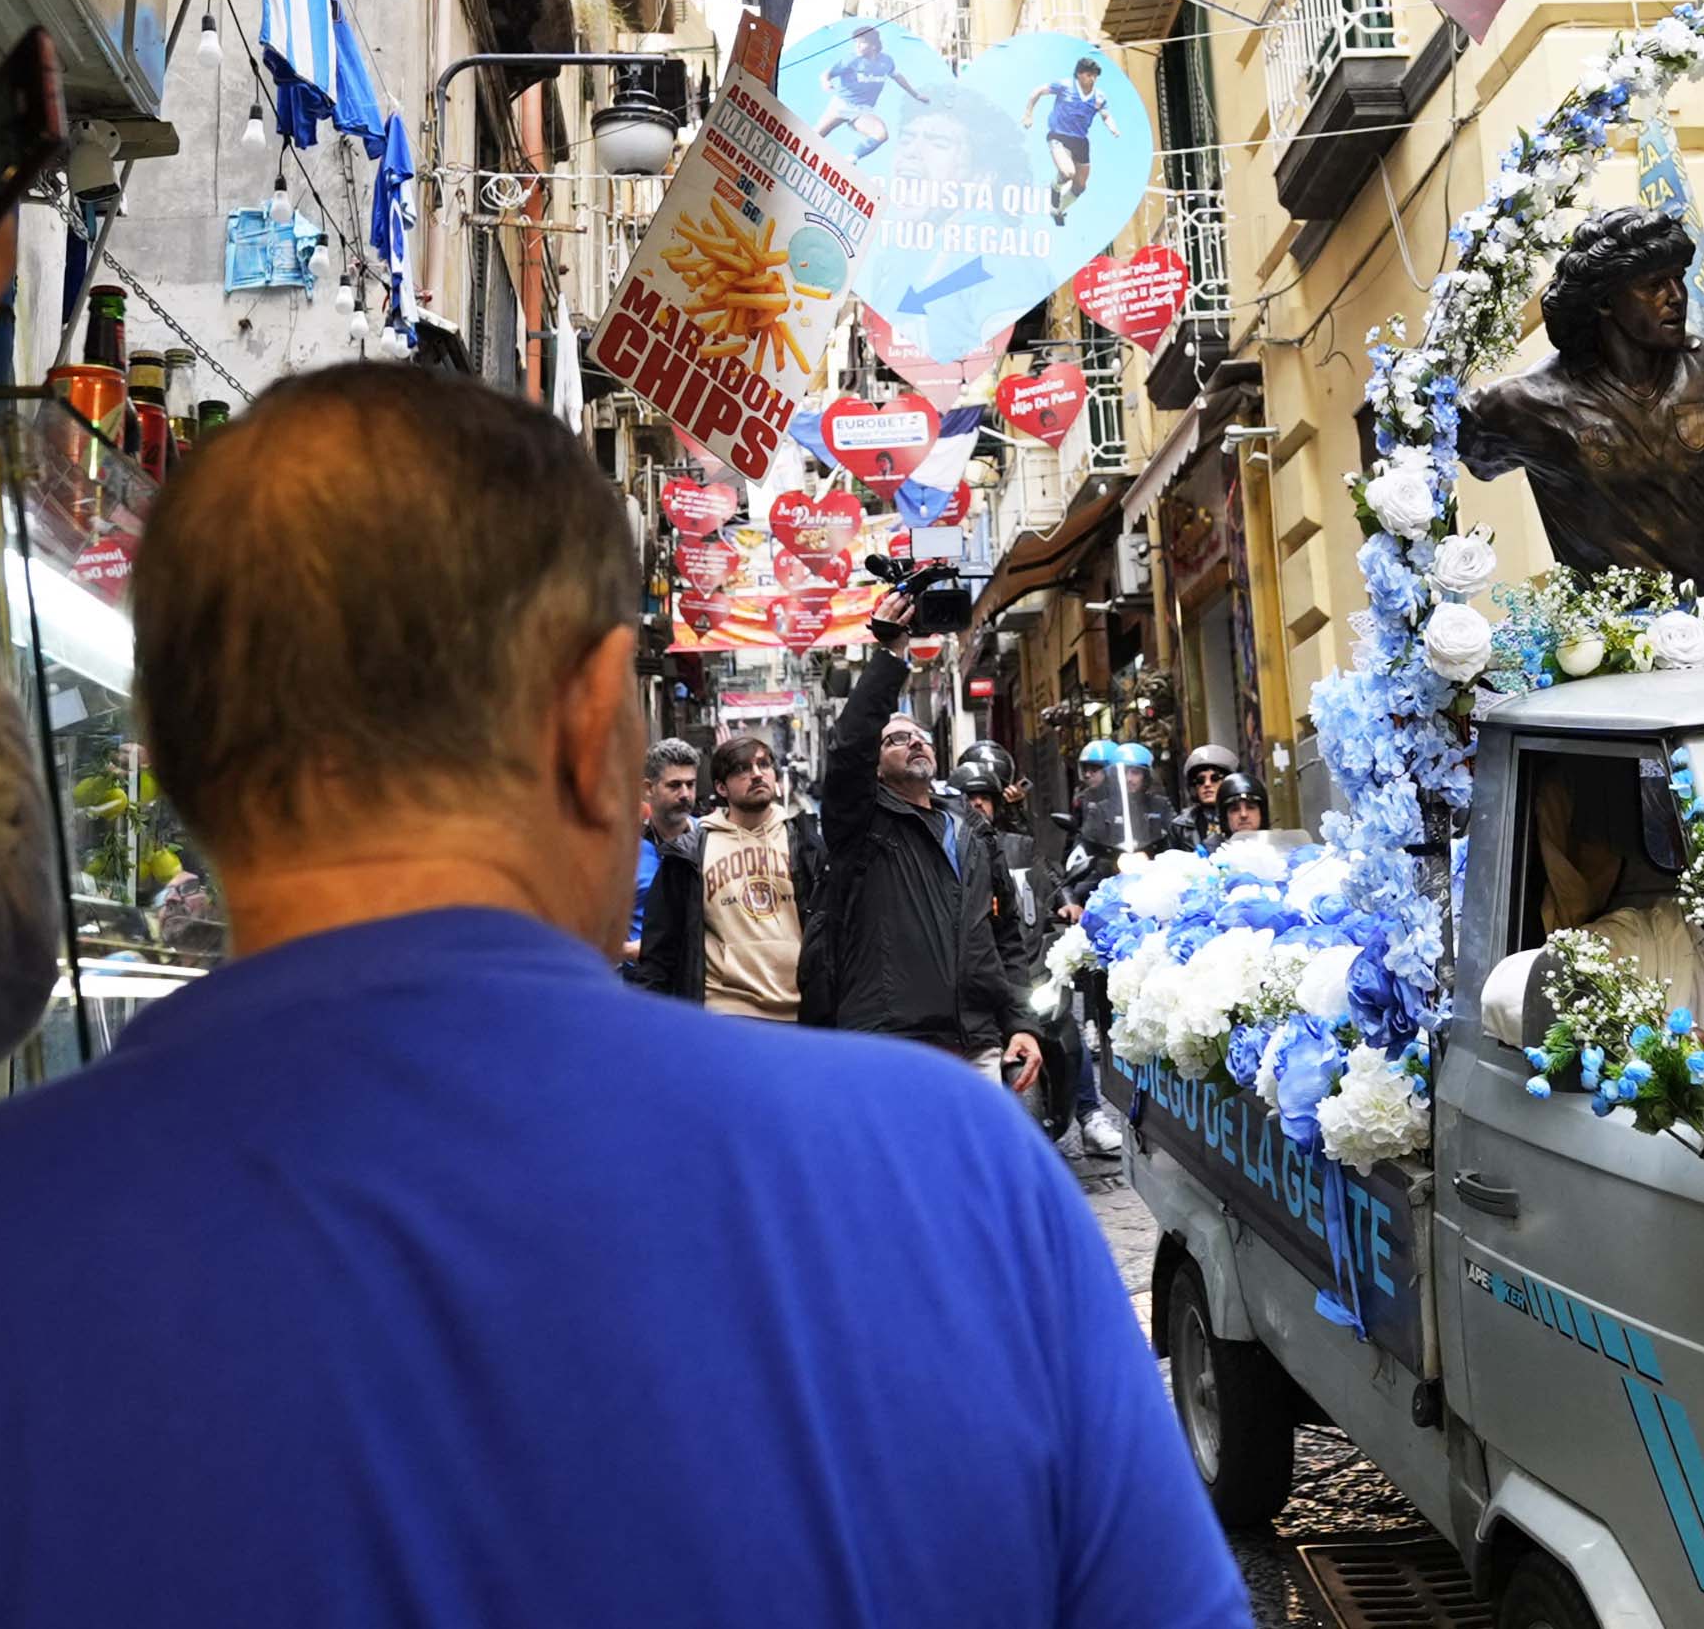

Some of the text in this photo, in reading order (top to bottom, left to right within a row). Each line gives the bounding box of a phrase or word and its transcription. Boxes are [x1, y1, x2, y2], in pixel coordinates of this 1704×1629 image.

[706, 128, 776, 193] CONO PATATE
[717, 102, 869, 244] MARADOHMAYO
[727, 84, 876, 219] ASSAGGIA LA NOSTRA
[880, 220, 934, 251] TUO
[943, 224, 1050, 258] REGALO
[620, 276, 795, 433] MARADOH
[597, 312, 778, 480] CHIPS
[836, 416, 905, 430] EUROBET
[1034, 397, 1049, 410] De
[706, 847, 793, 902] BROOKLY
[721, 896, 738, 906] USA
[1204, 1082, 1237, 1164] DE
[1241, 1101, 1278, 1201] LA
[1282, 1137, 1395, 1298] GETE
[1467, 1263, 1491, 1290] APE
